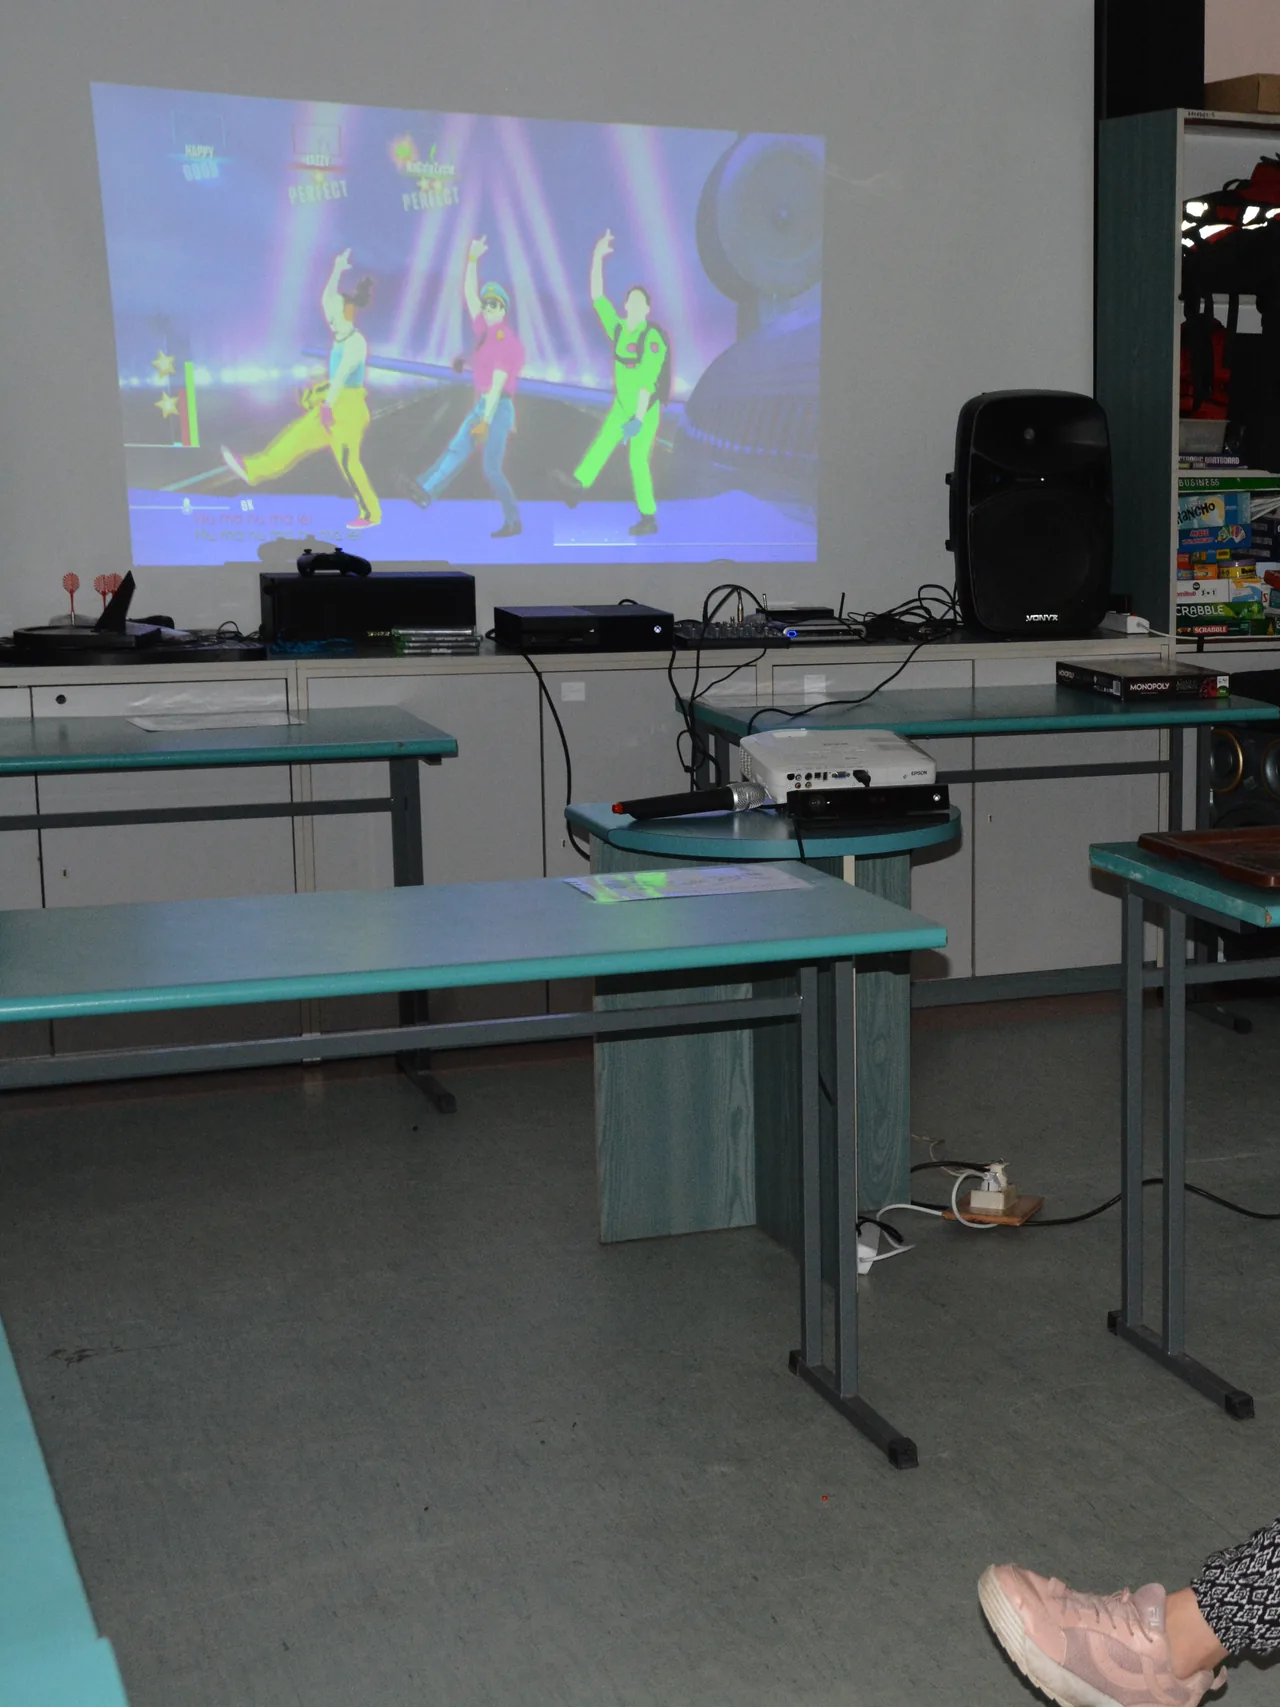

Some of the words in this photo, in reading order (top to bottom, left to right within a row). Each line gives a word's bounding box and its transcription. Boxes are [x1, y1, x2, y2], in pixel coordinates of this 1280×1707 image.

[288, 180, 348, 204] PERFECT
[1026, 614, 1059, 622] VONYX
[1194, 625, 1227, 633] SCRABBLE
[1130, 682, 1170, 691] MONOPOLY
